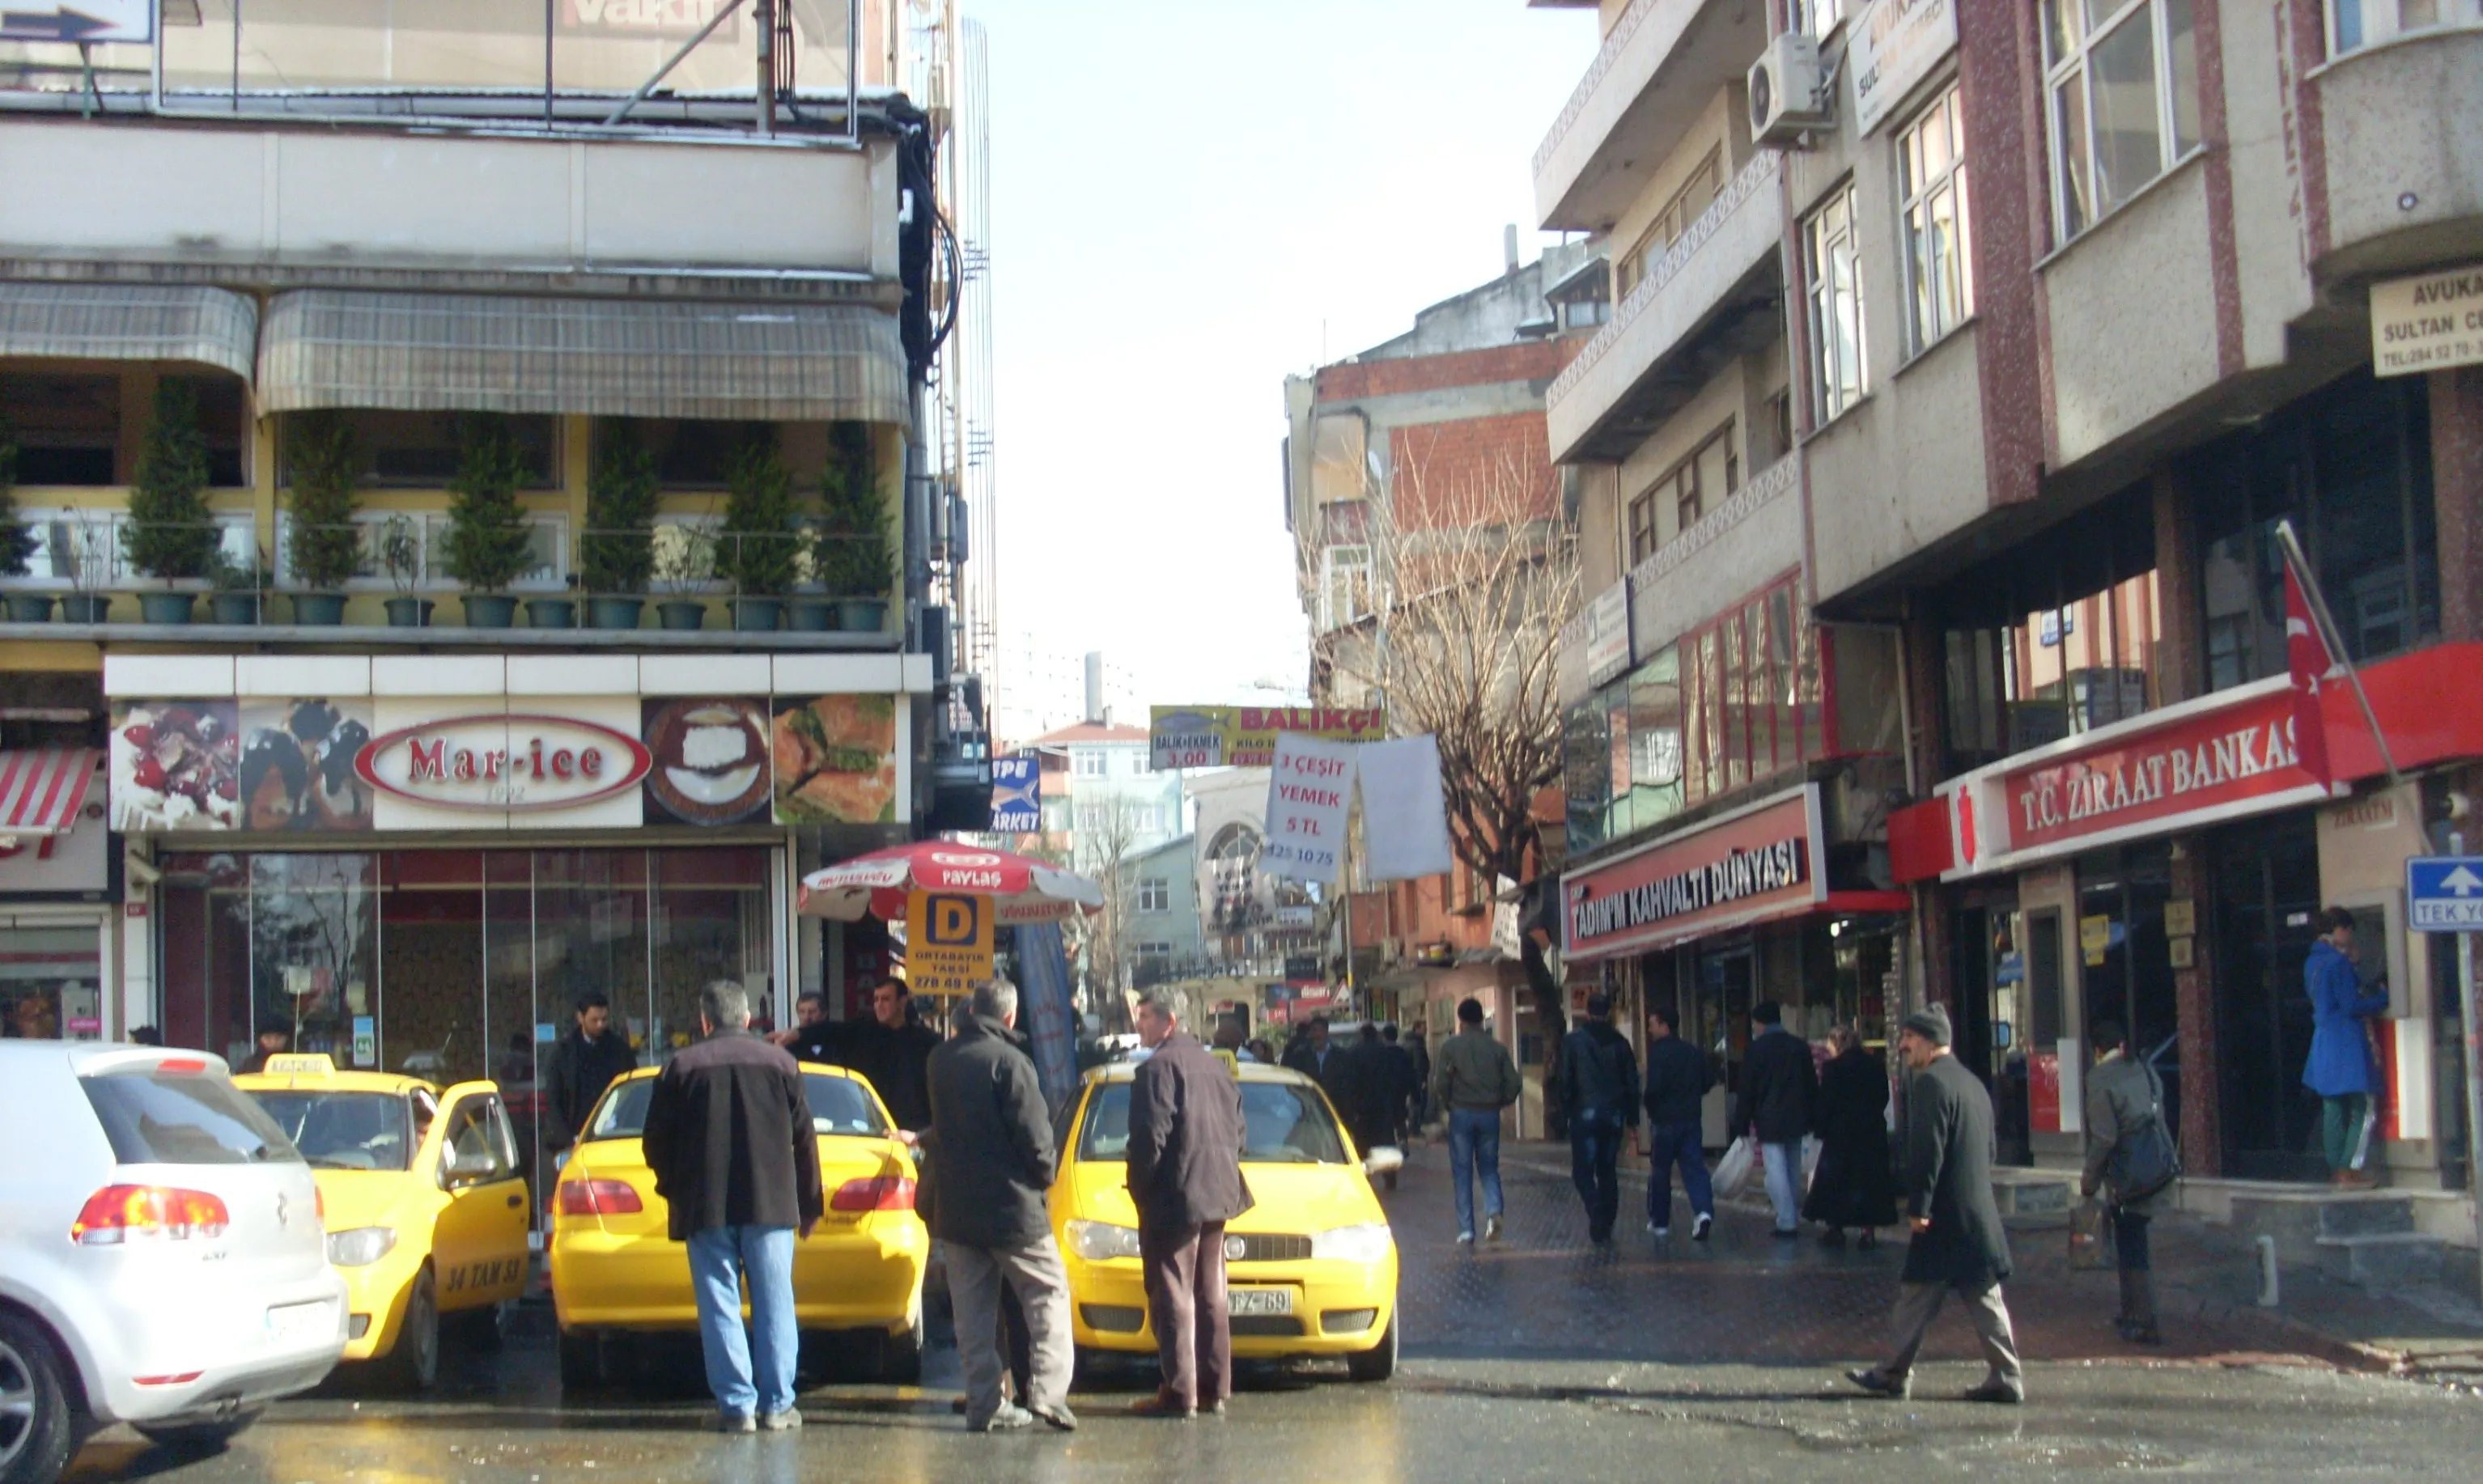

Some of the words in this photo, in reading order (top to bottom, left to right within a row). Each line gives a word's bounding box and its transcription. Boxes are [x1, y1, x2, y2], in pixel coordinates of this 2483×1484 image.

[2384, 312, 2453, 343] SULTAN
[1241, 707, 1381, 733] BALIKÇI
[406, 736, 602, 780] Mar-ice
[1280, 753, 1291, 770] 3
[1295, 755, 1346, 778] ÇEŞİT
[2021, 787, 2062, 831] T.C.
[2068, 753, 2166, 820] ZİRAAT
[2171, 715, 2299, 795] BANKAS
[1280, 782, 1341, 808] YEMEK
[991, 811, 1039, 833] ARKET
[1285, 815, 1297, 833] 5
[1302, 816, 1321, 837] TL
[1298, 846, 1314, 863] 10
[942, 869, 1002, 889] PAYLAŞ
[1628, 865, 1708, 924] KAHVALTI
[1711, 837, 1798, 904] DÜNYASI
[935, 898, 973, 939] D
[2421, 903, 2457, 921] TEK
